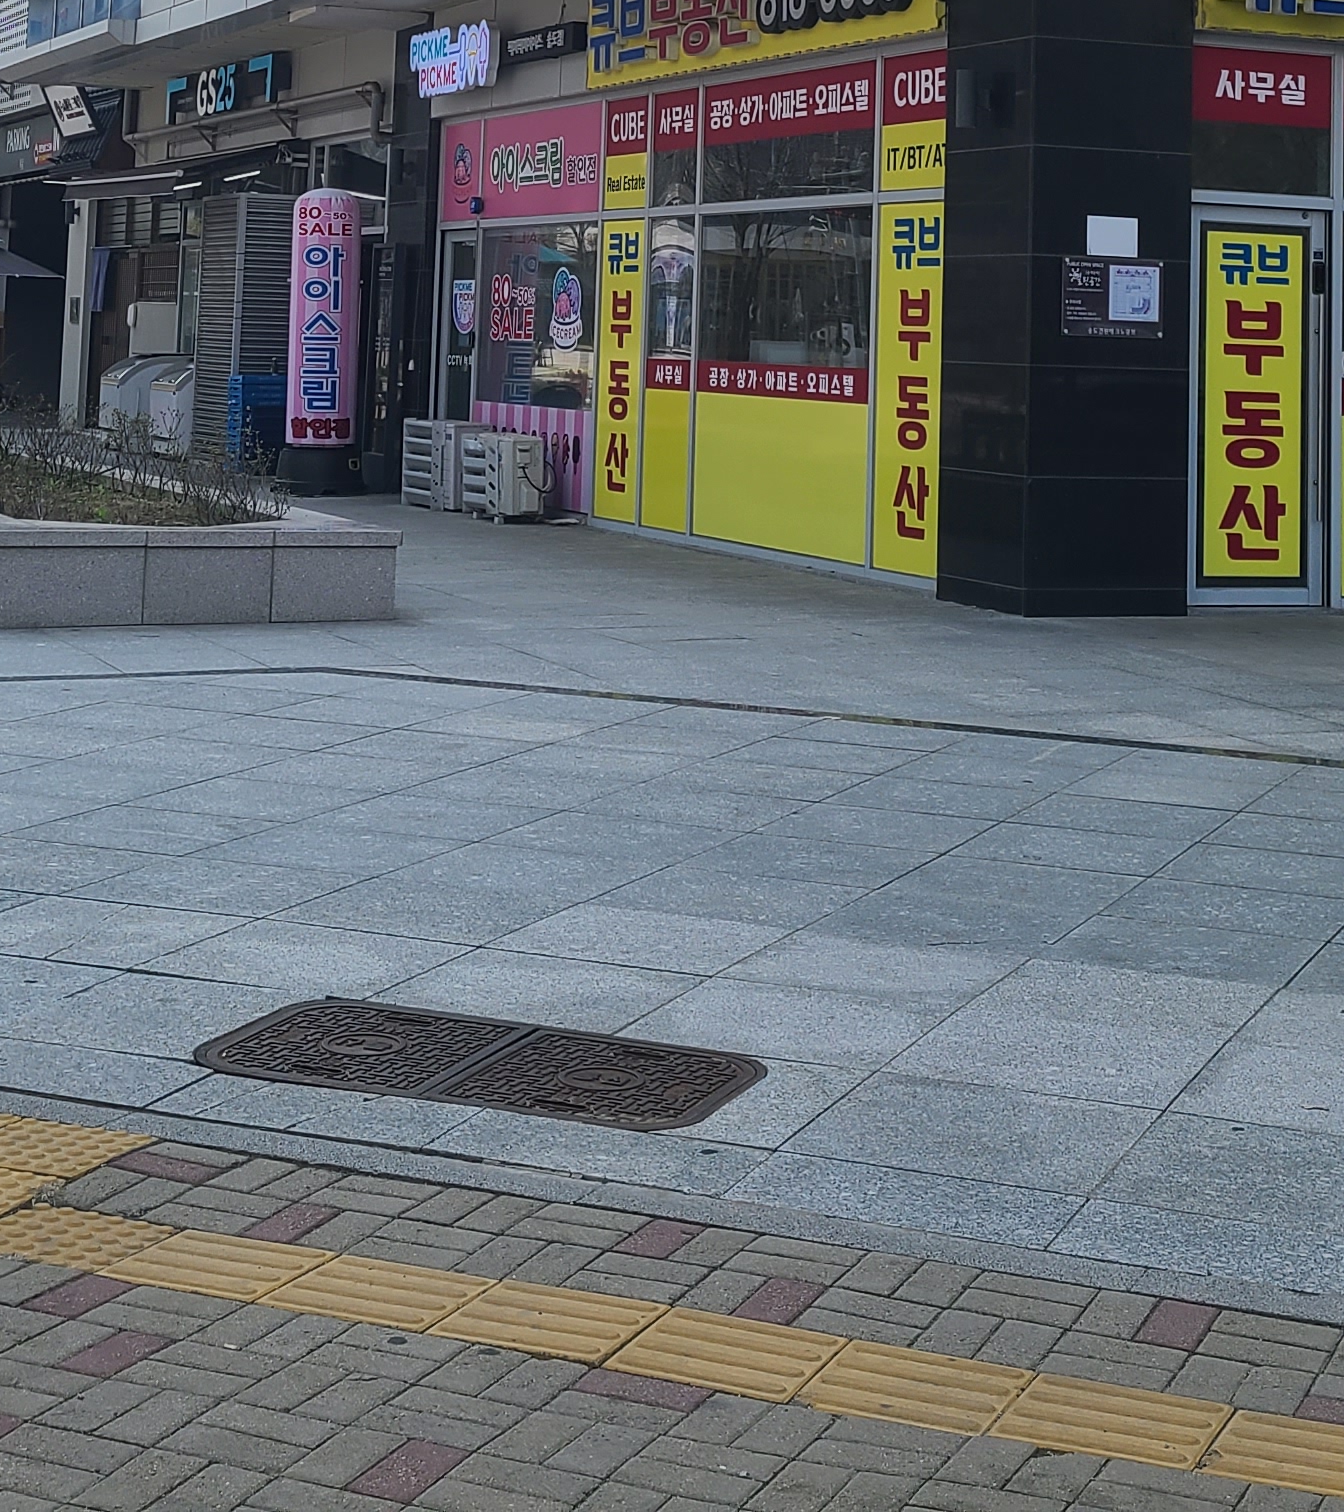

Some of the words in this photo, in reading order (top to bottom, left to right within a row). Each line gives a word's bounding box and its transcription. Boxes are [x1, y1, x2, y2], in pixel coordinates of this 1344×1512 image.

[411, 35, 449, 65] PICKME
[197, 64, 236, 117] GS25
[420, 61, 458, 92] PICKME
[893, 65, 946, 109] CUBE
[1216, 68, 1307, 108] 사무실
[6, 125, 30, 153] PARKING
[610, 109, 646, 144] CUBE
[658, 104, 695, 135] 사무실
[490, 137, 564, 193] 아이스크림
[566, 152, 597, 185] 할인점
[606, 174, 622, 193] Real
[622, 172, 646, 191] Estate
[297, 222, 354, 237] SALE
[892, 215, 942, 271] 큐브
[608, 231, 639, 275] 큐브
[1219, 242, 1290, 286] 큐브
[300, 244, 347, 414] 아이스크림
[490, 307, 535, 341] SALE
[447, 354, 463, 366] CCTV
[654, 365, 684, 386] 사무실
[604, 289, 631, 493] 부동산
[892, 287, 932, 540] 부동산
[1217, 299, 1288, 561] 부동산
